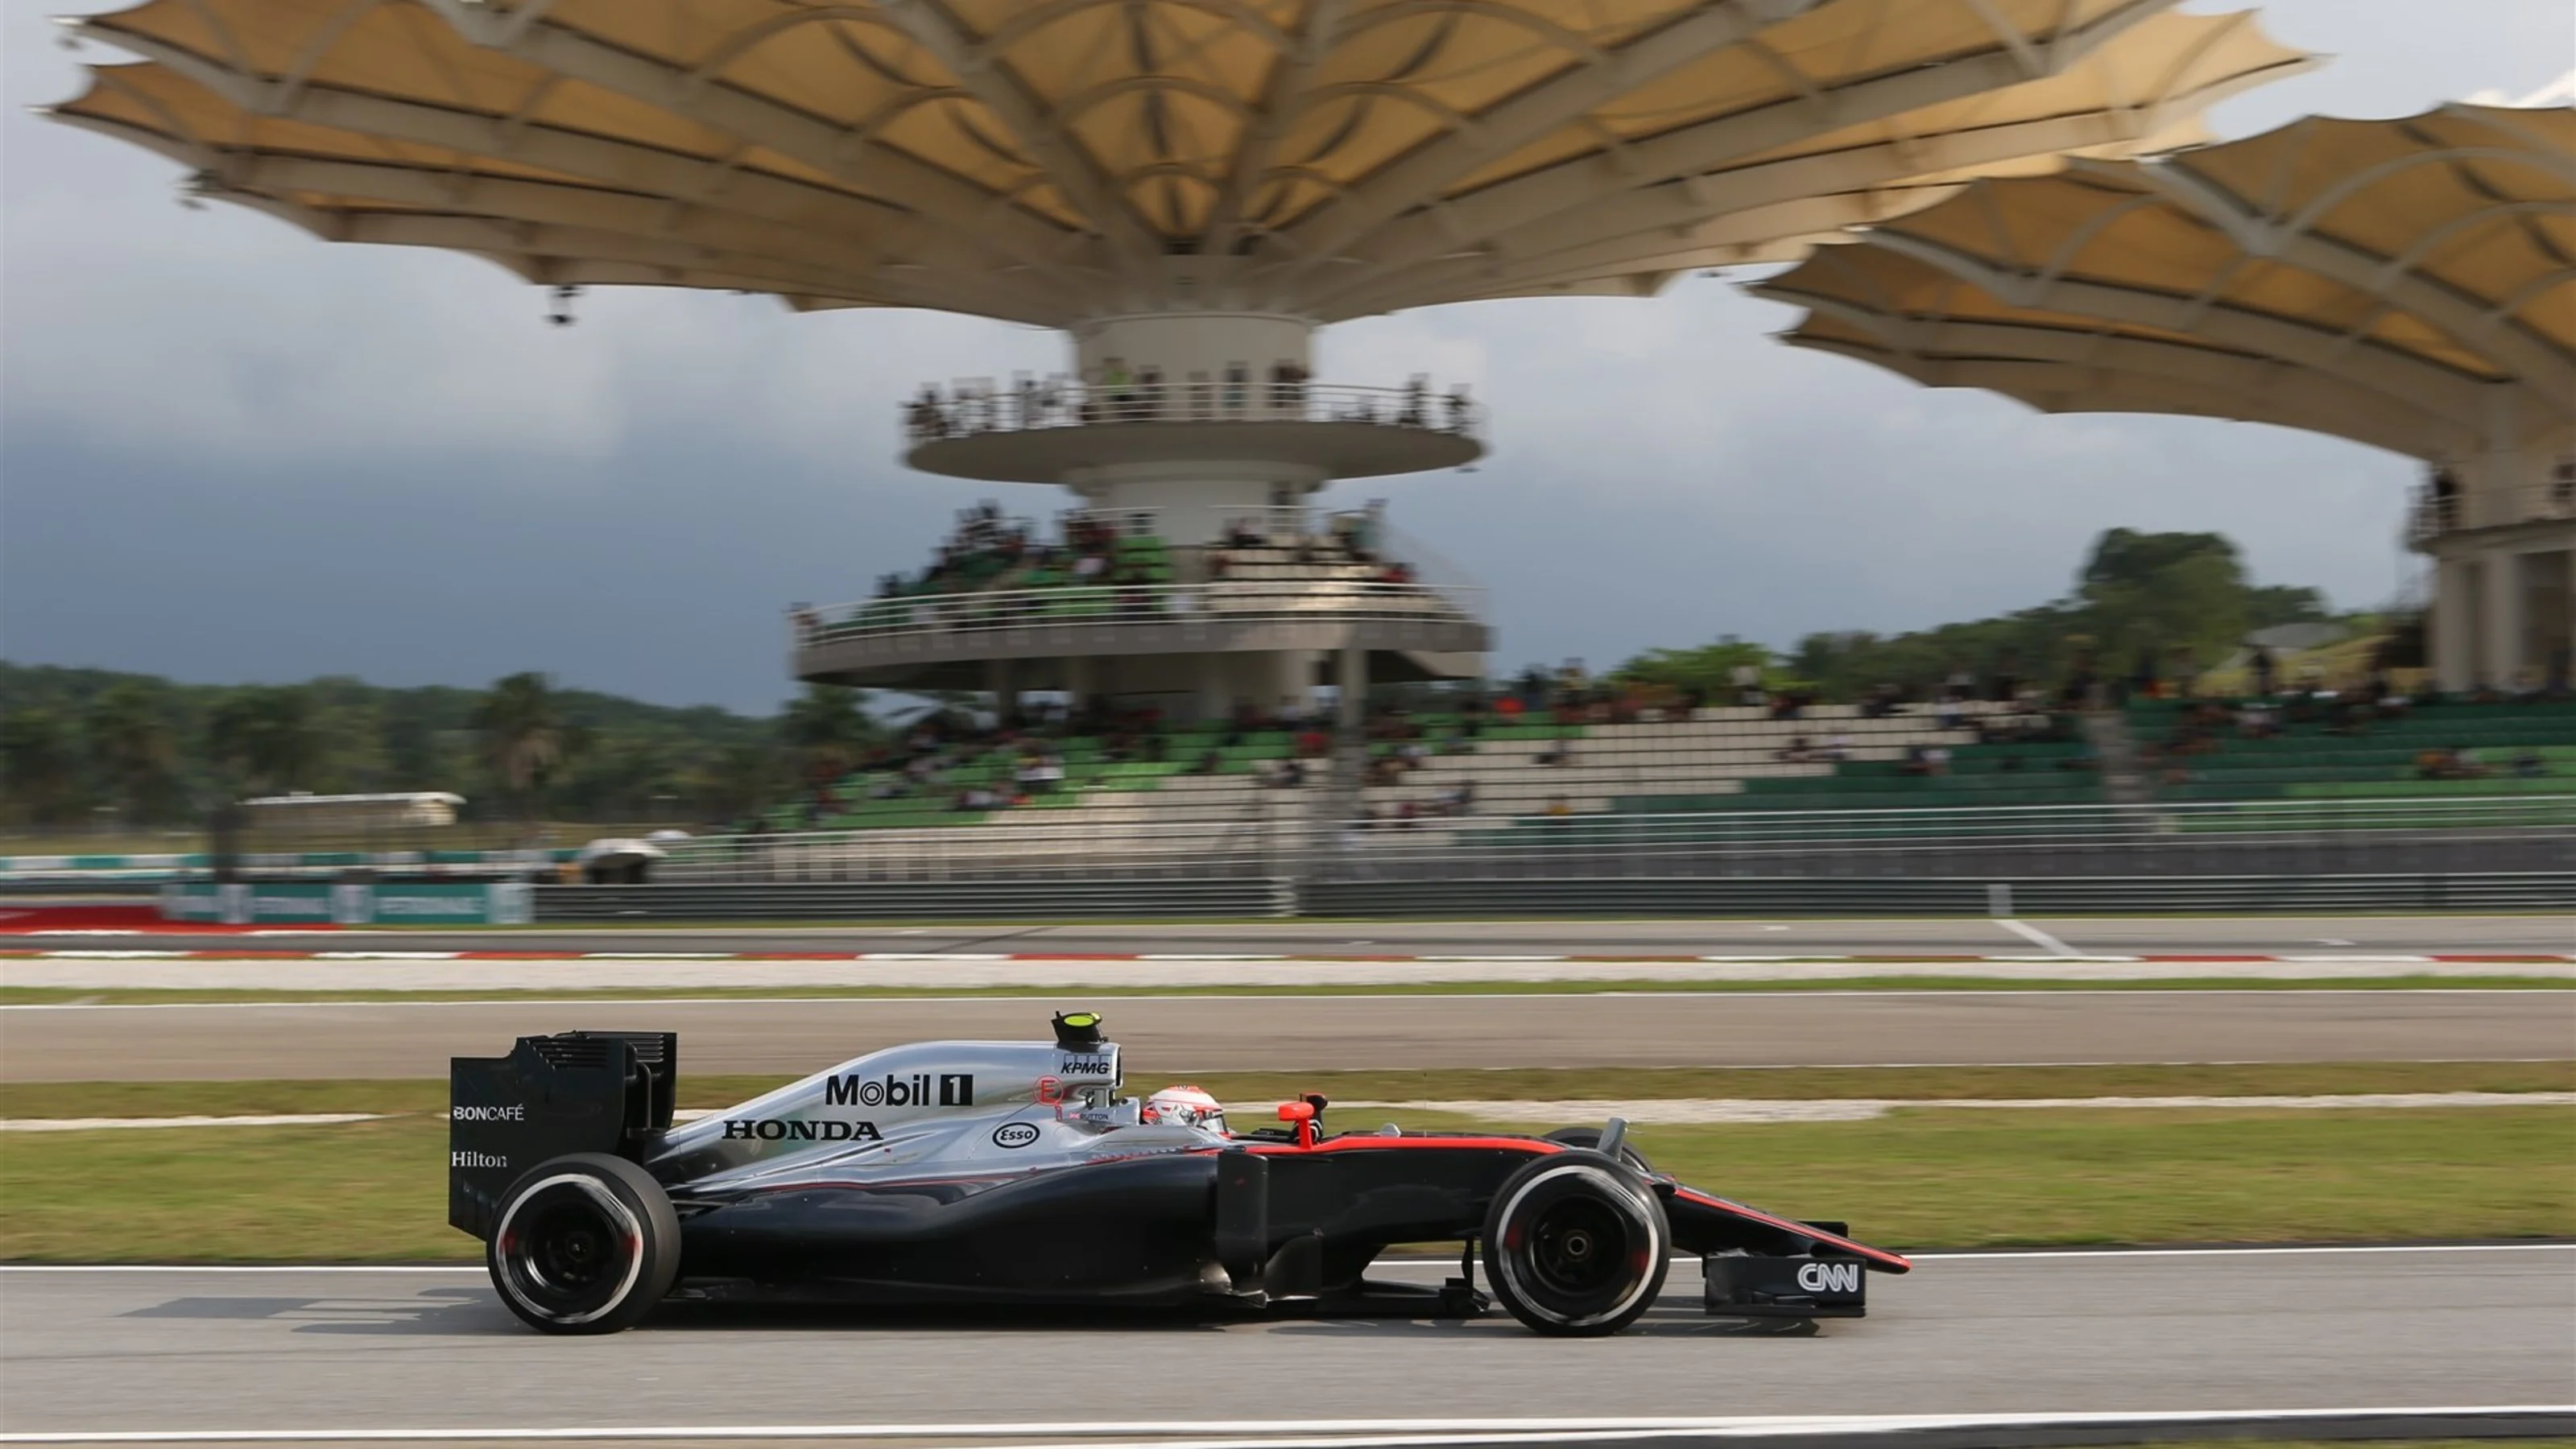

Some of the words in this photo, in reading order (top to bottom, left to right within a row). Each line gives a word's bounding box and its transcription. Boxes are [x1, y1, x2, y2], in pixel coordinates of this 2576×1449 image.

[1061, 1062, 1110, 1075] KPMG
[825, 1074, 931, 1106] Mobil
[1040, 1080, 1056, 1104] E
[453, 1103, 524, 1121] BONCAFÉ
[722, 1119, 884, 1141] HONDA
[452, 1150, 507, 1168] Hilton
[1797, 1262, 1859, 1293] CNN
